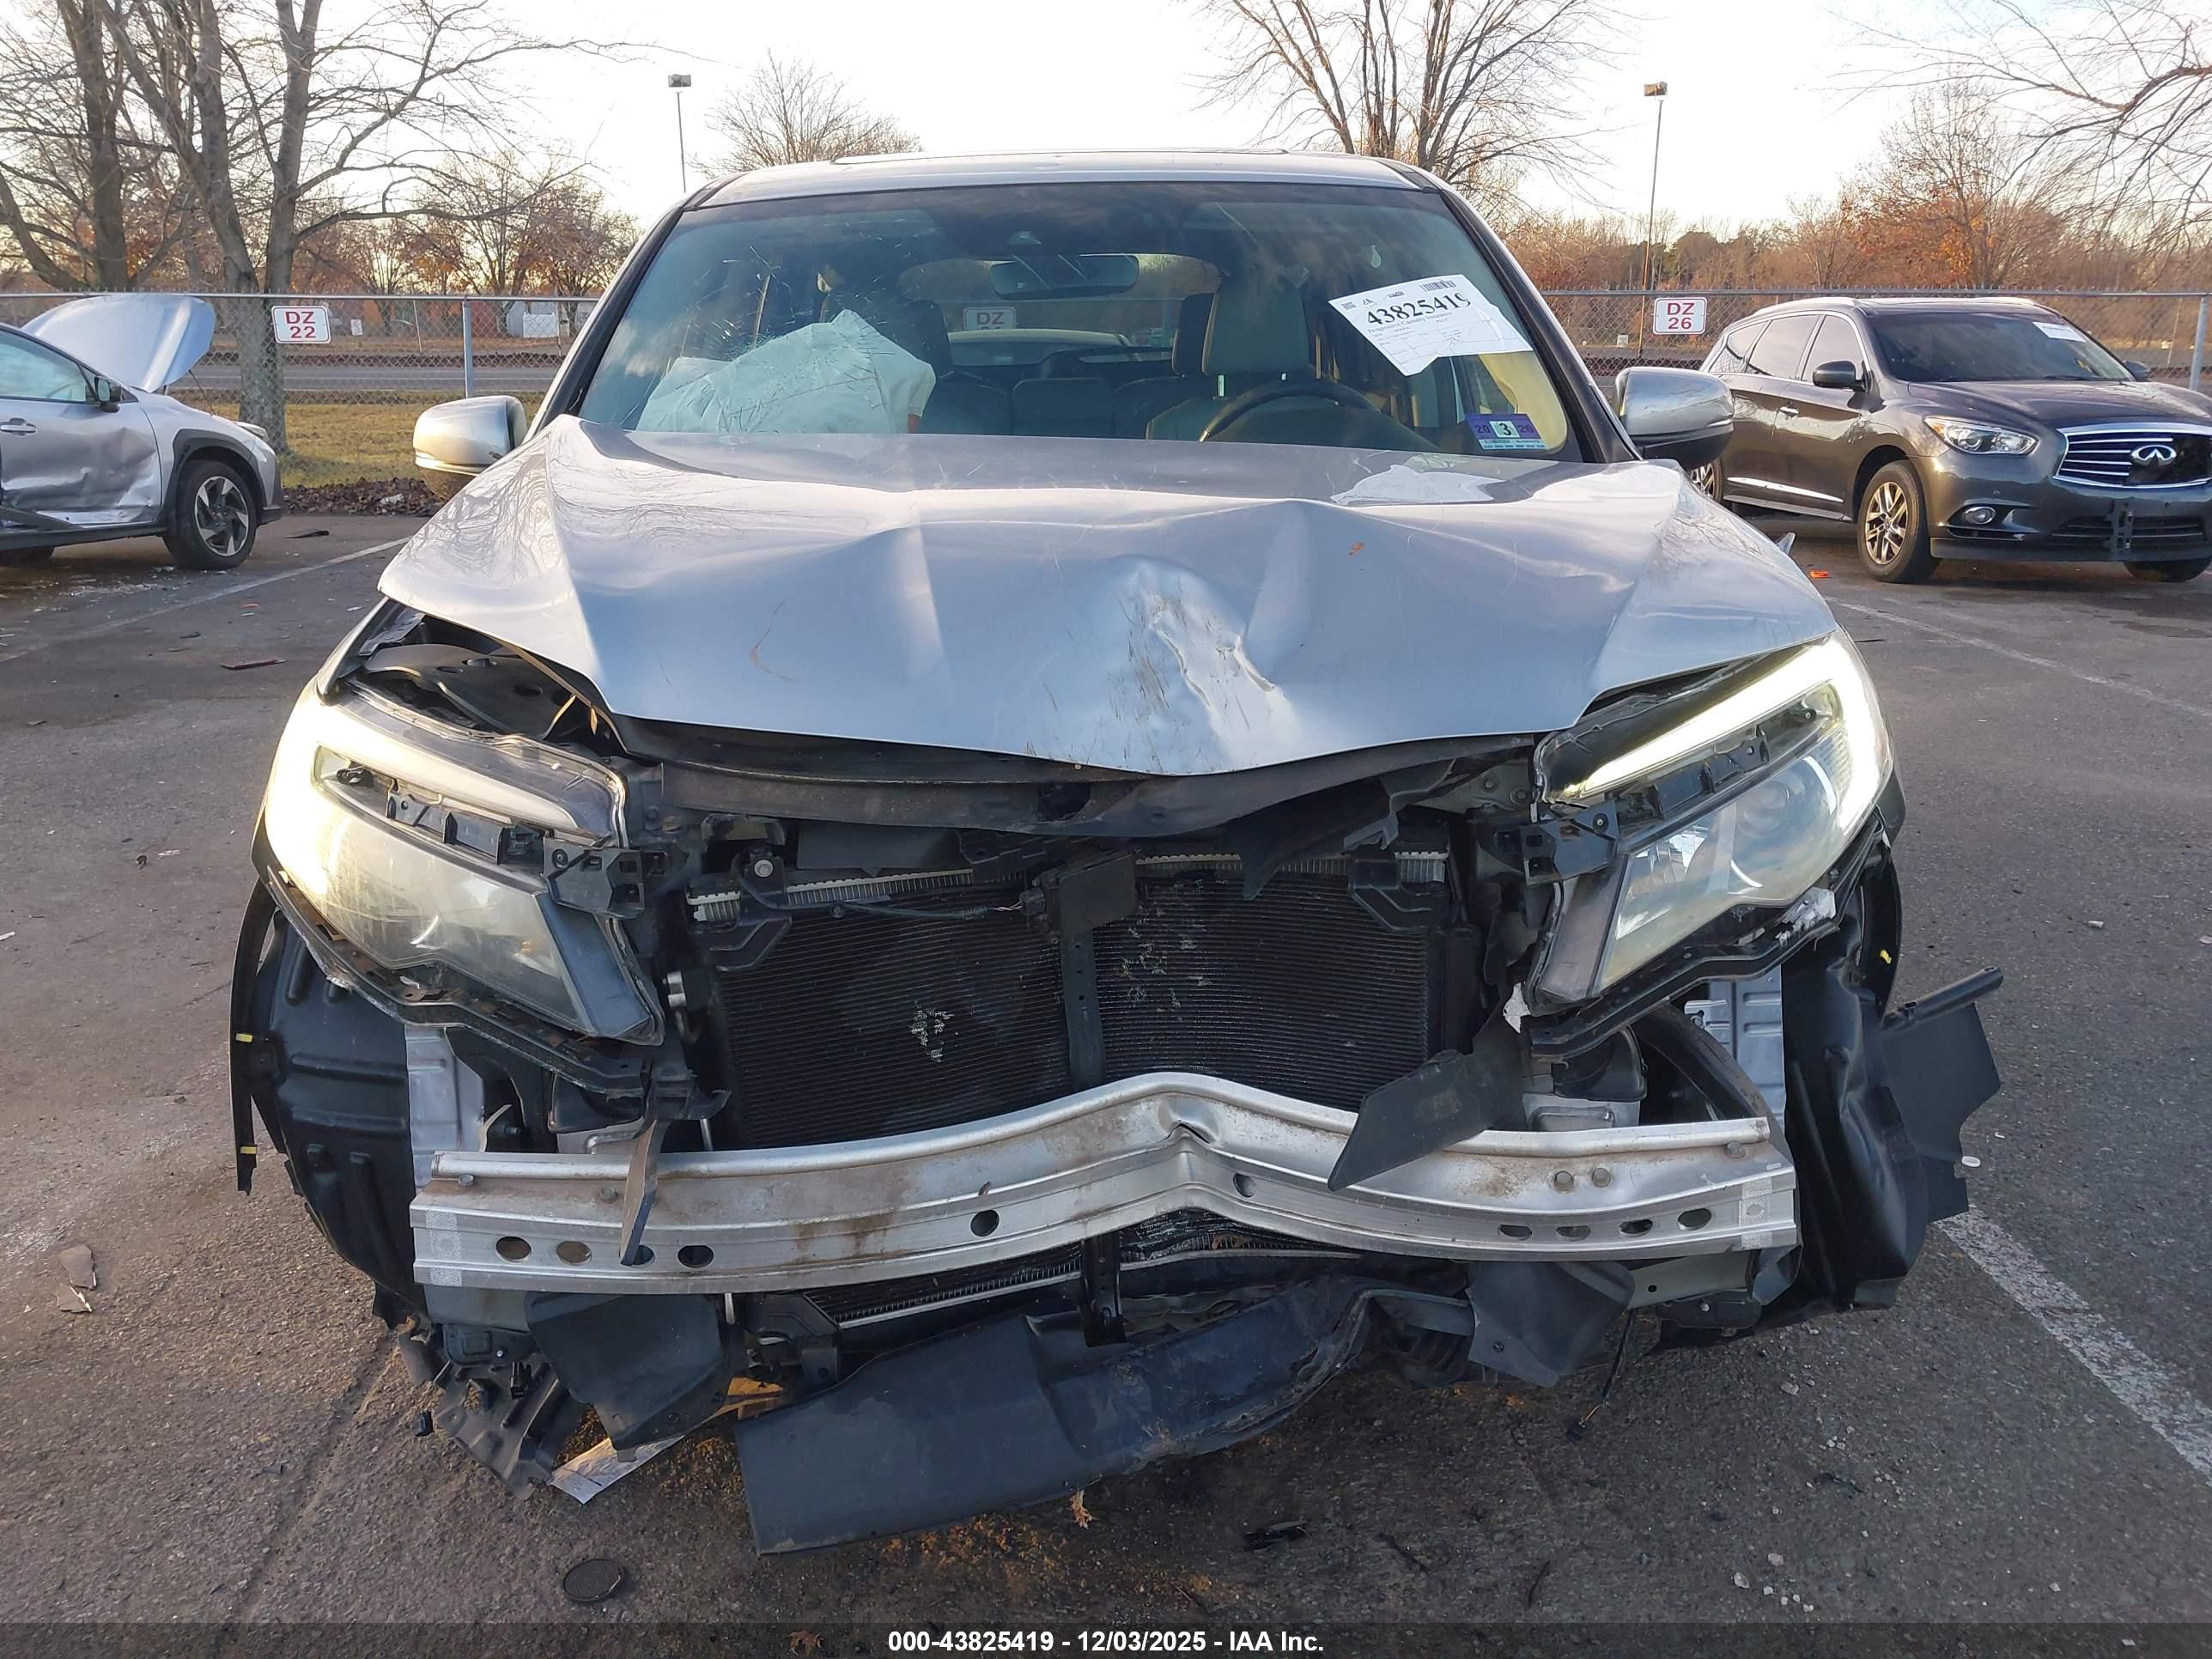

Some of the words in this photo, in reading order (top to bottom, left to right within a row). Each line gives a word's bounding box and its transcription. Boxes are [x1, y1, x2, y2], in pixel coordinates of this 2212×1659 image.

[1667, 302, 1695, 315] DZ
[285, 311, 316, 324] DZ
[976, 312, 1004, 325] DZ
[1668, 317, 1692, 330] 26
[289, 325, 316, 338] 22
[1475, 424, 1491, 434] 20
[1498, 422, 1512, 436] 3
